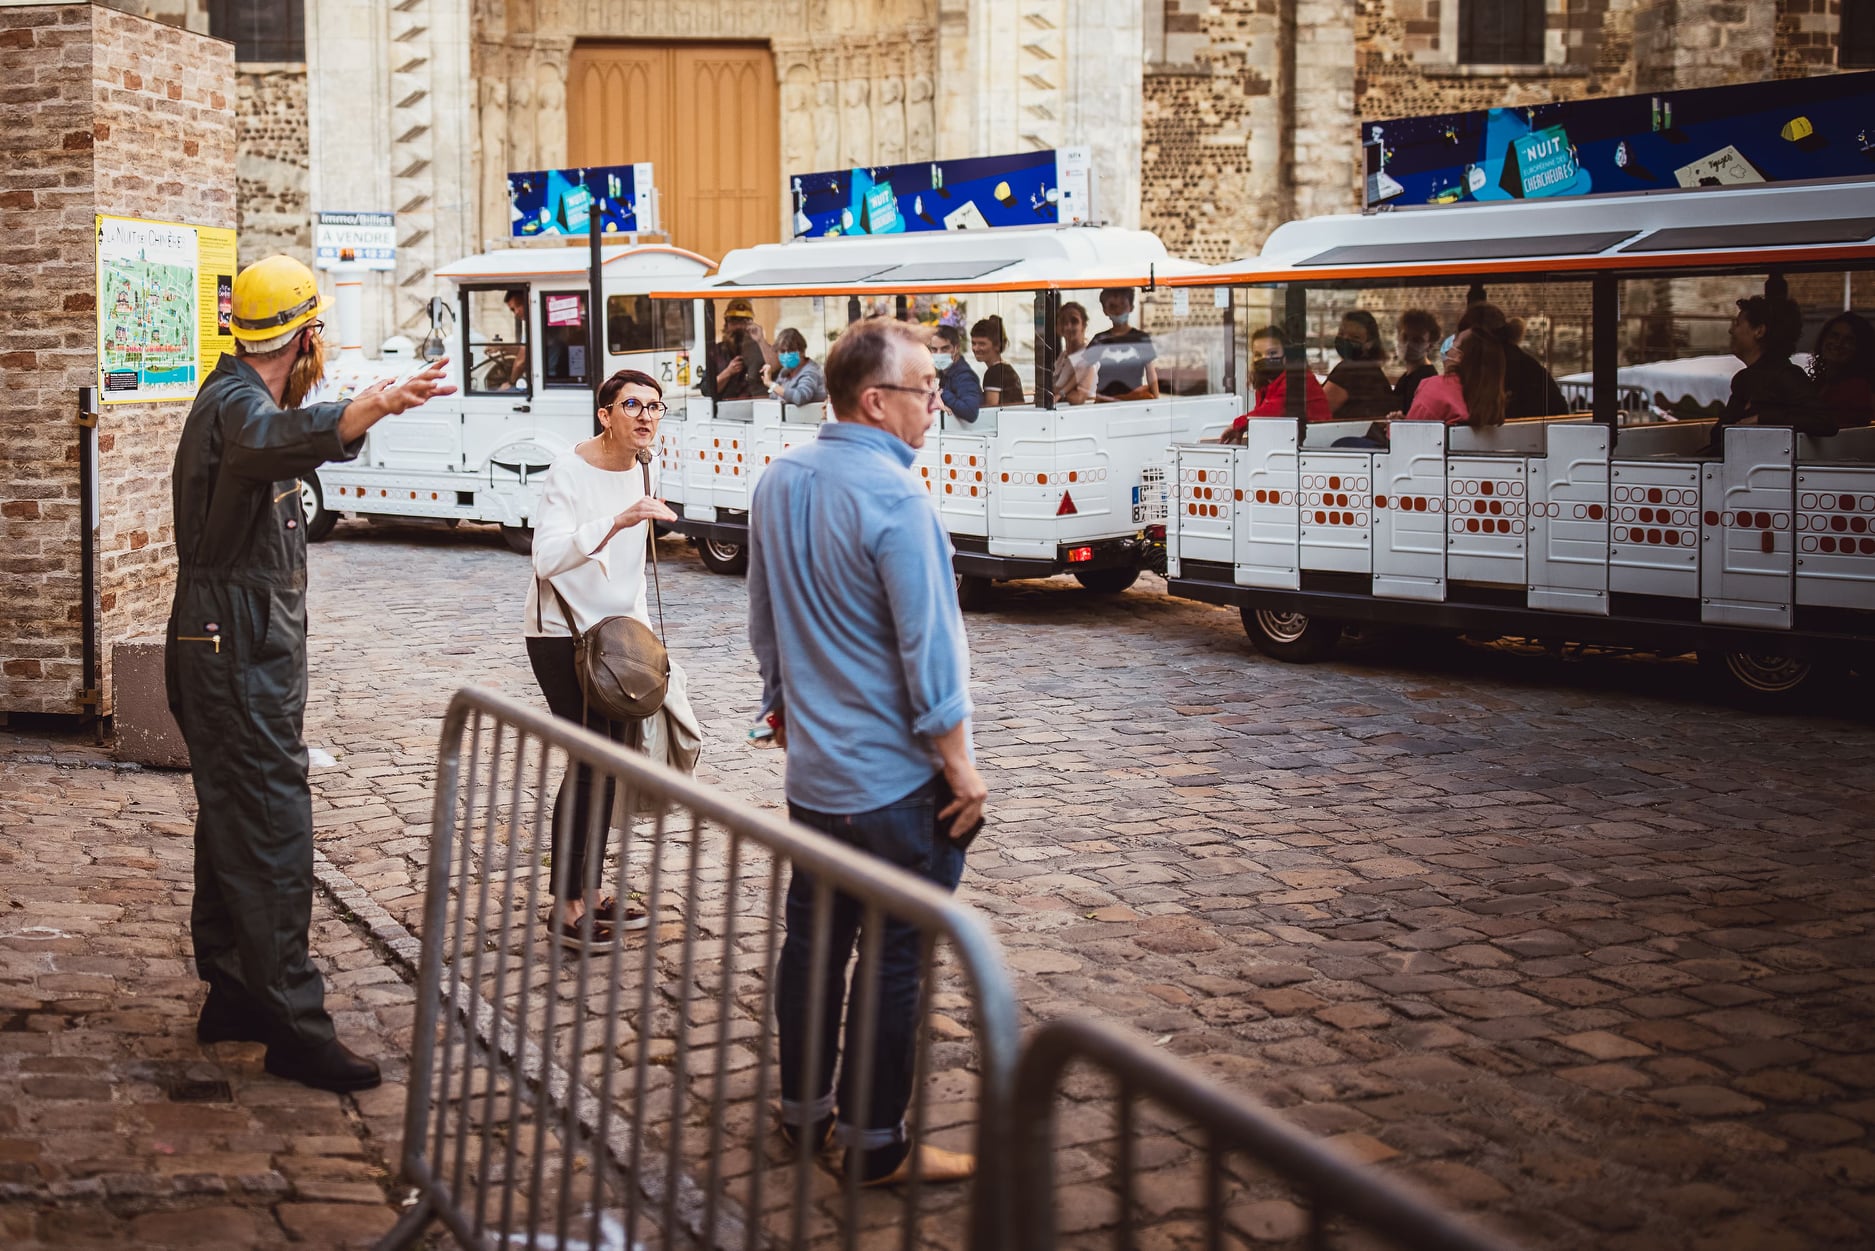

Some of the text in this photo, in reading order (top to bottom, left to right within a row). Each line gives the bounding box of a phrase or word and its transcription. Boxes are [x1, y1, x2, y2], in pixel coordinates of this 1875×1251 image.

[1527, 136, 1560, 162] NUIT
[117, 226, 136, 246] NUIT
[336, 231, 390, 243] VENDRE
